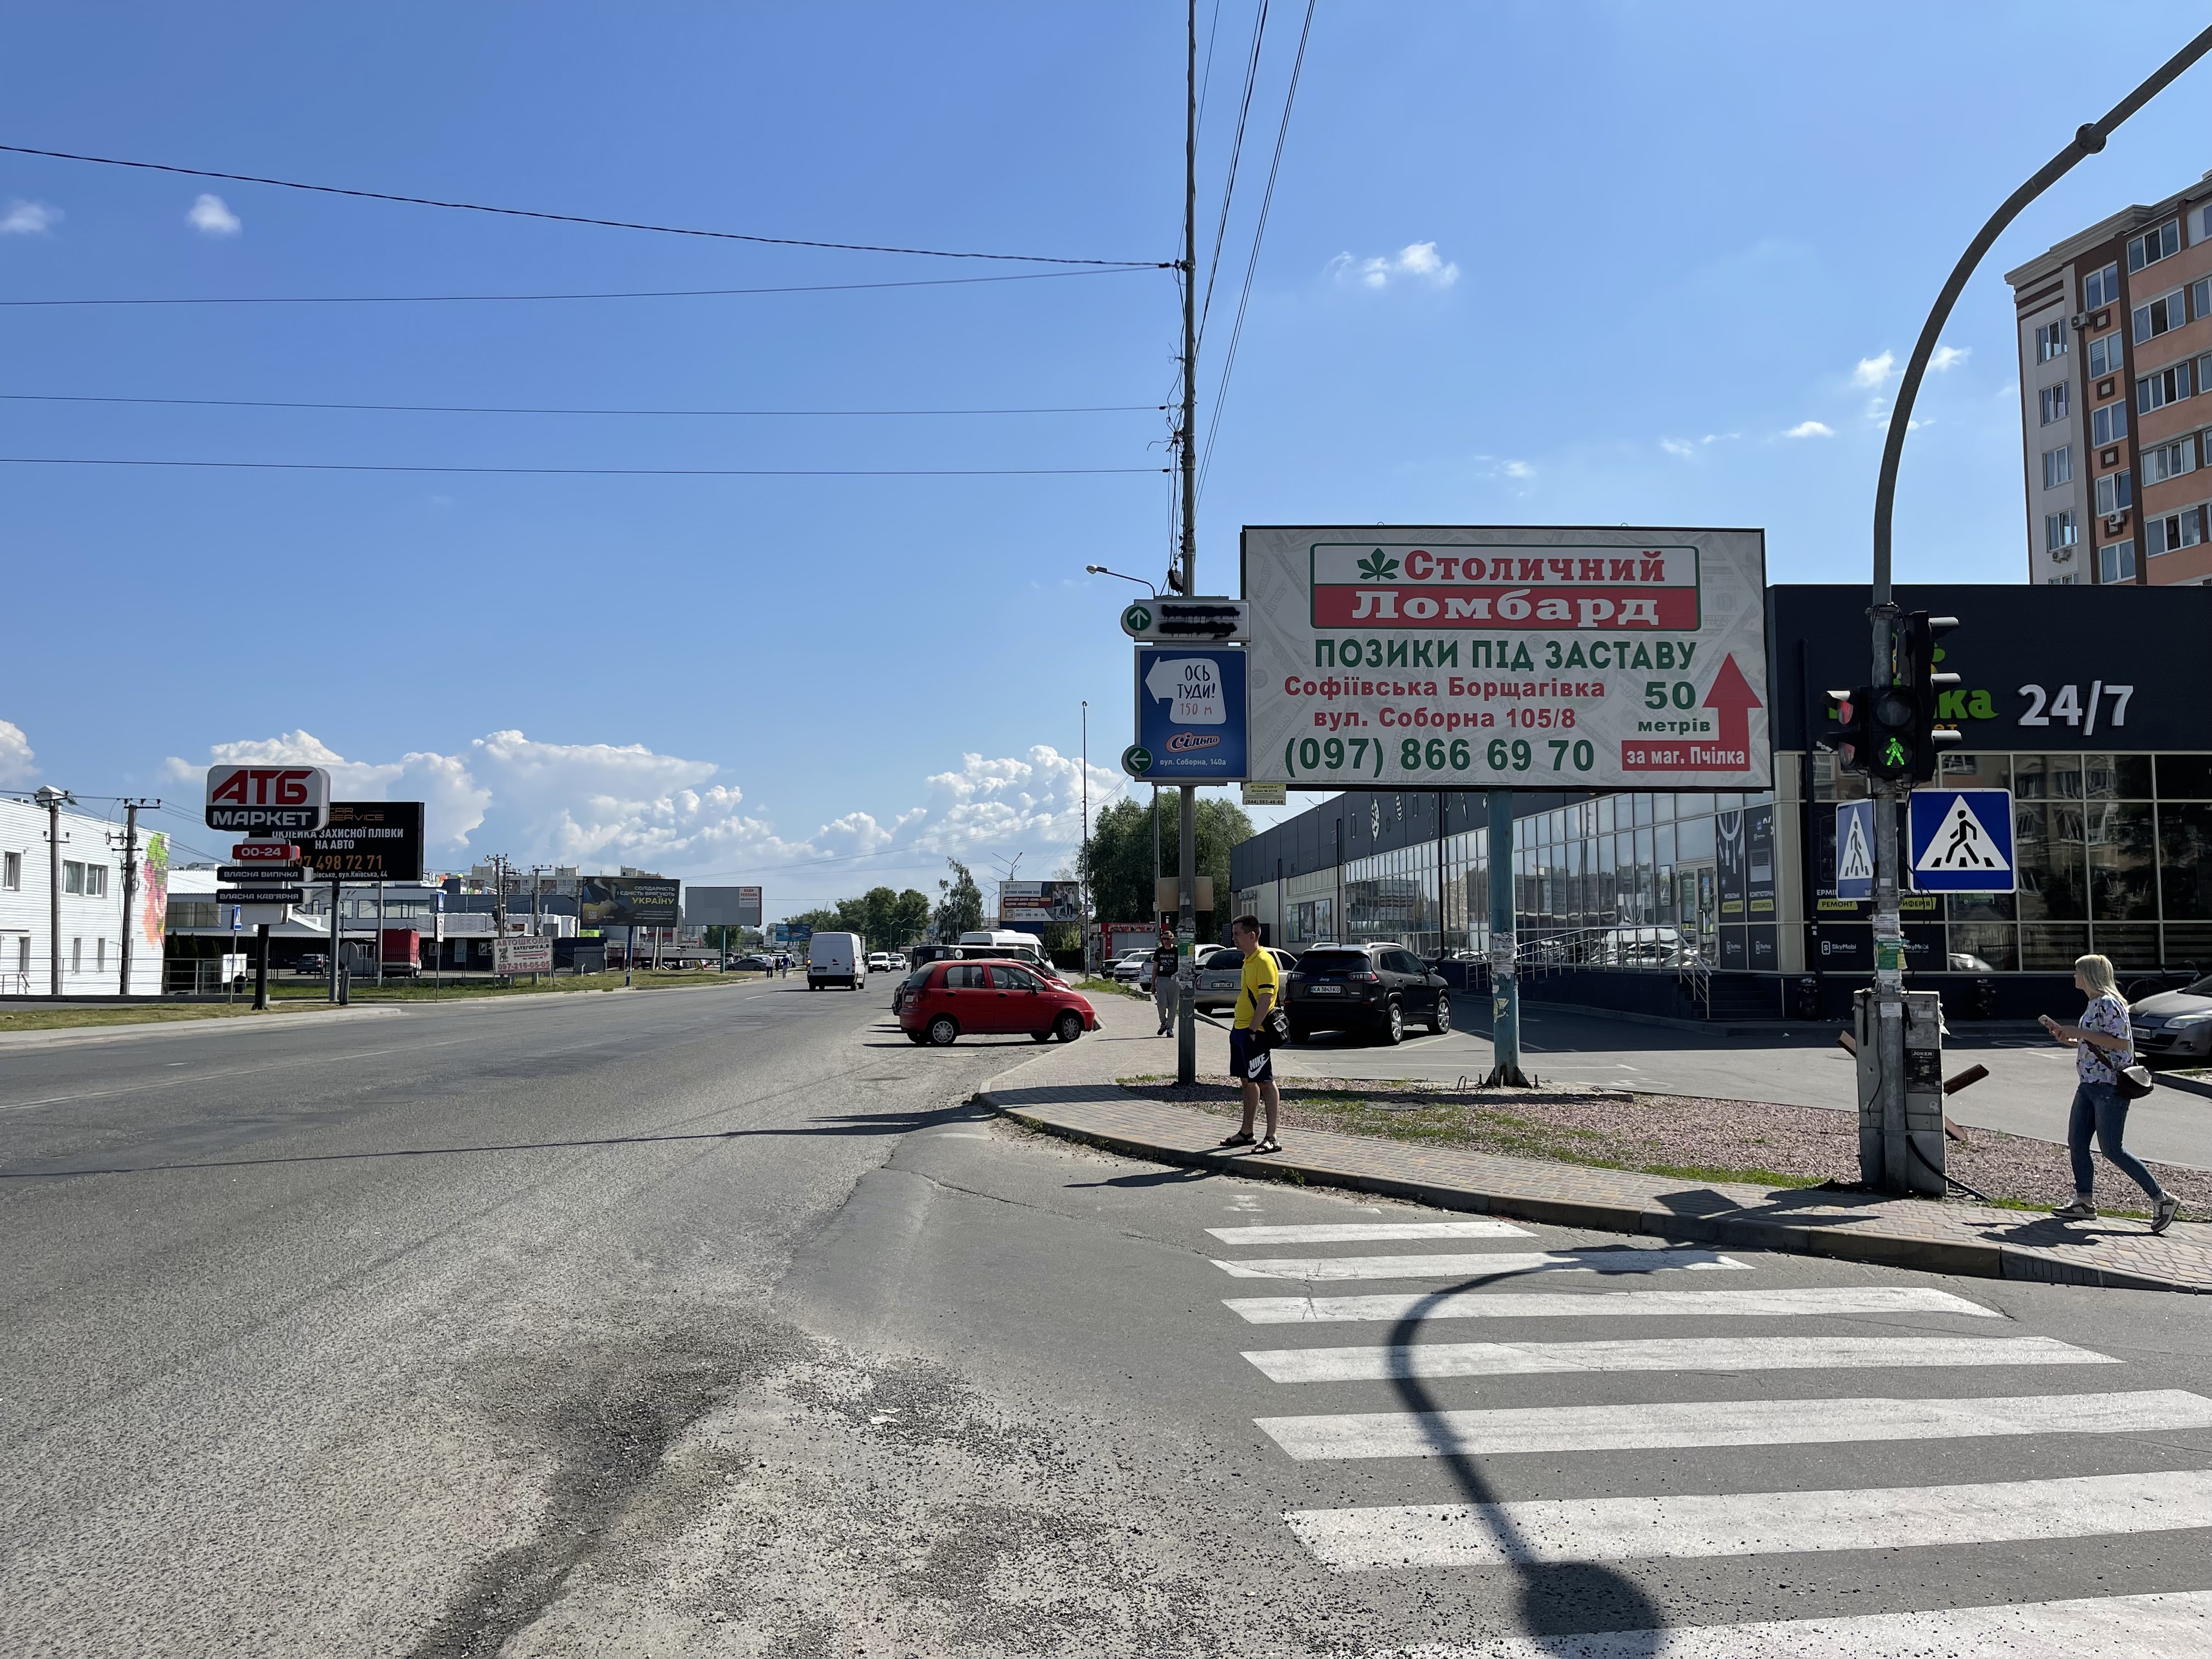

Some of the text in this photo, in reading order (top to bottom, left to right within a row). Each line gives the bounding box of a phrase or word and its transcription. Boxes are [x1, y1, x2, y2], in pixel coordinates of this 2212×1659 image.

[1404, 550, 1664, 582] Столичний
[1352, 589, 1658, 628] Ломбард
[1315, 639, 1697, 672] ПОЗИКИ ПІД ЗАСТАВУ
[1184, 664, 1210, 682] ОСЬ
[1176, 682, 1216, 699] ТУДИ!
[1284, 676, 1605, 701] Софіївська Борщагівка
[1644, 680, 1696, 710] 50
[1180, 703, 1213, 715] 150 м
[2017, 680, 2134, 736] 24/7
[1314, 707, 1576, 731] вул. Соборна 105/8
[1638, 718, 1711, 736] метрів
[1170, 734, 1219, 751] Сільпо
[1160, 758, 1226, 767] вул. Соборна, 140а
[1285, 738, 1595, 777] (097) 866 69 70
[1626, 746, 1745, 767] за маг. Пчілка
[212, 769, 314, 805] АТБ
[212, 811, 312, 826] МАРКЕТ
[319, 827, 367, 838] ЗАХИСНОЇ
[368, 829, 403, 838] ПЛІВКИ
[315, 840, 354, 849] НА АВТО
[315, 855, 341, 870] 498
[346, 855, 363, 870] 72
[366, 855, 382, 870] 71
[632, 896, 675, 905] УКРАЇНУ
[496, 937, 550, 947] АВТОШКОЛА
[498, 961, 550, 970] 097-216-05-05
[1249, 1053, 1266, 1071] NIKE
